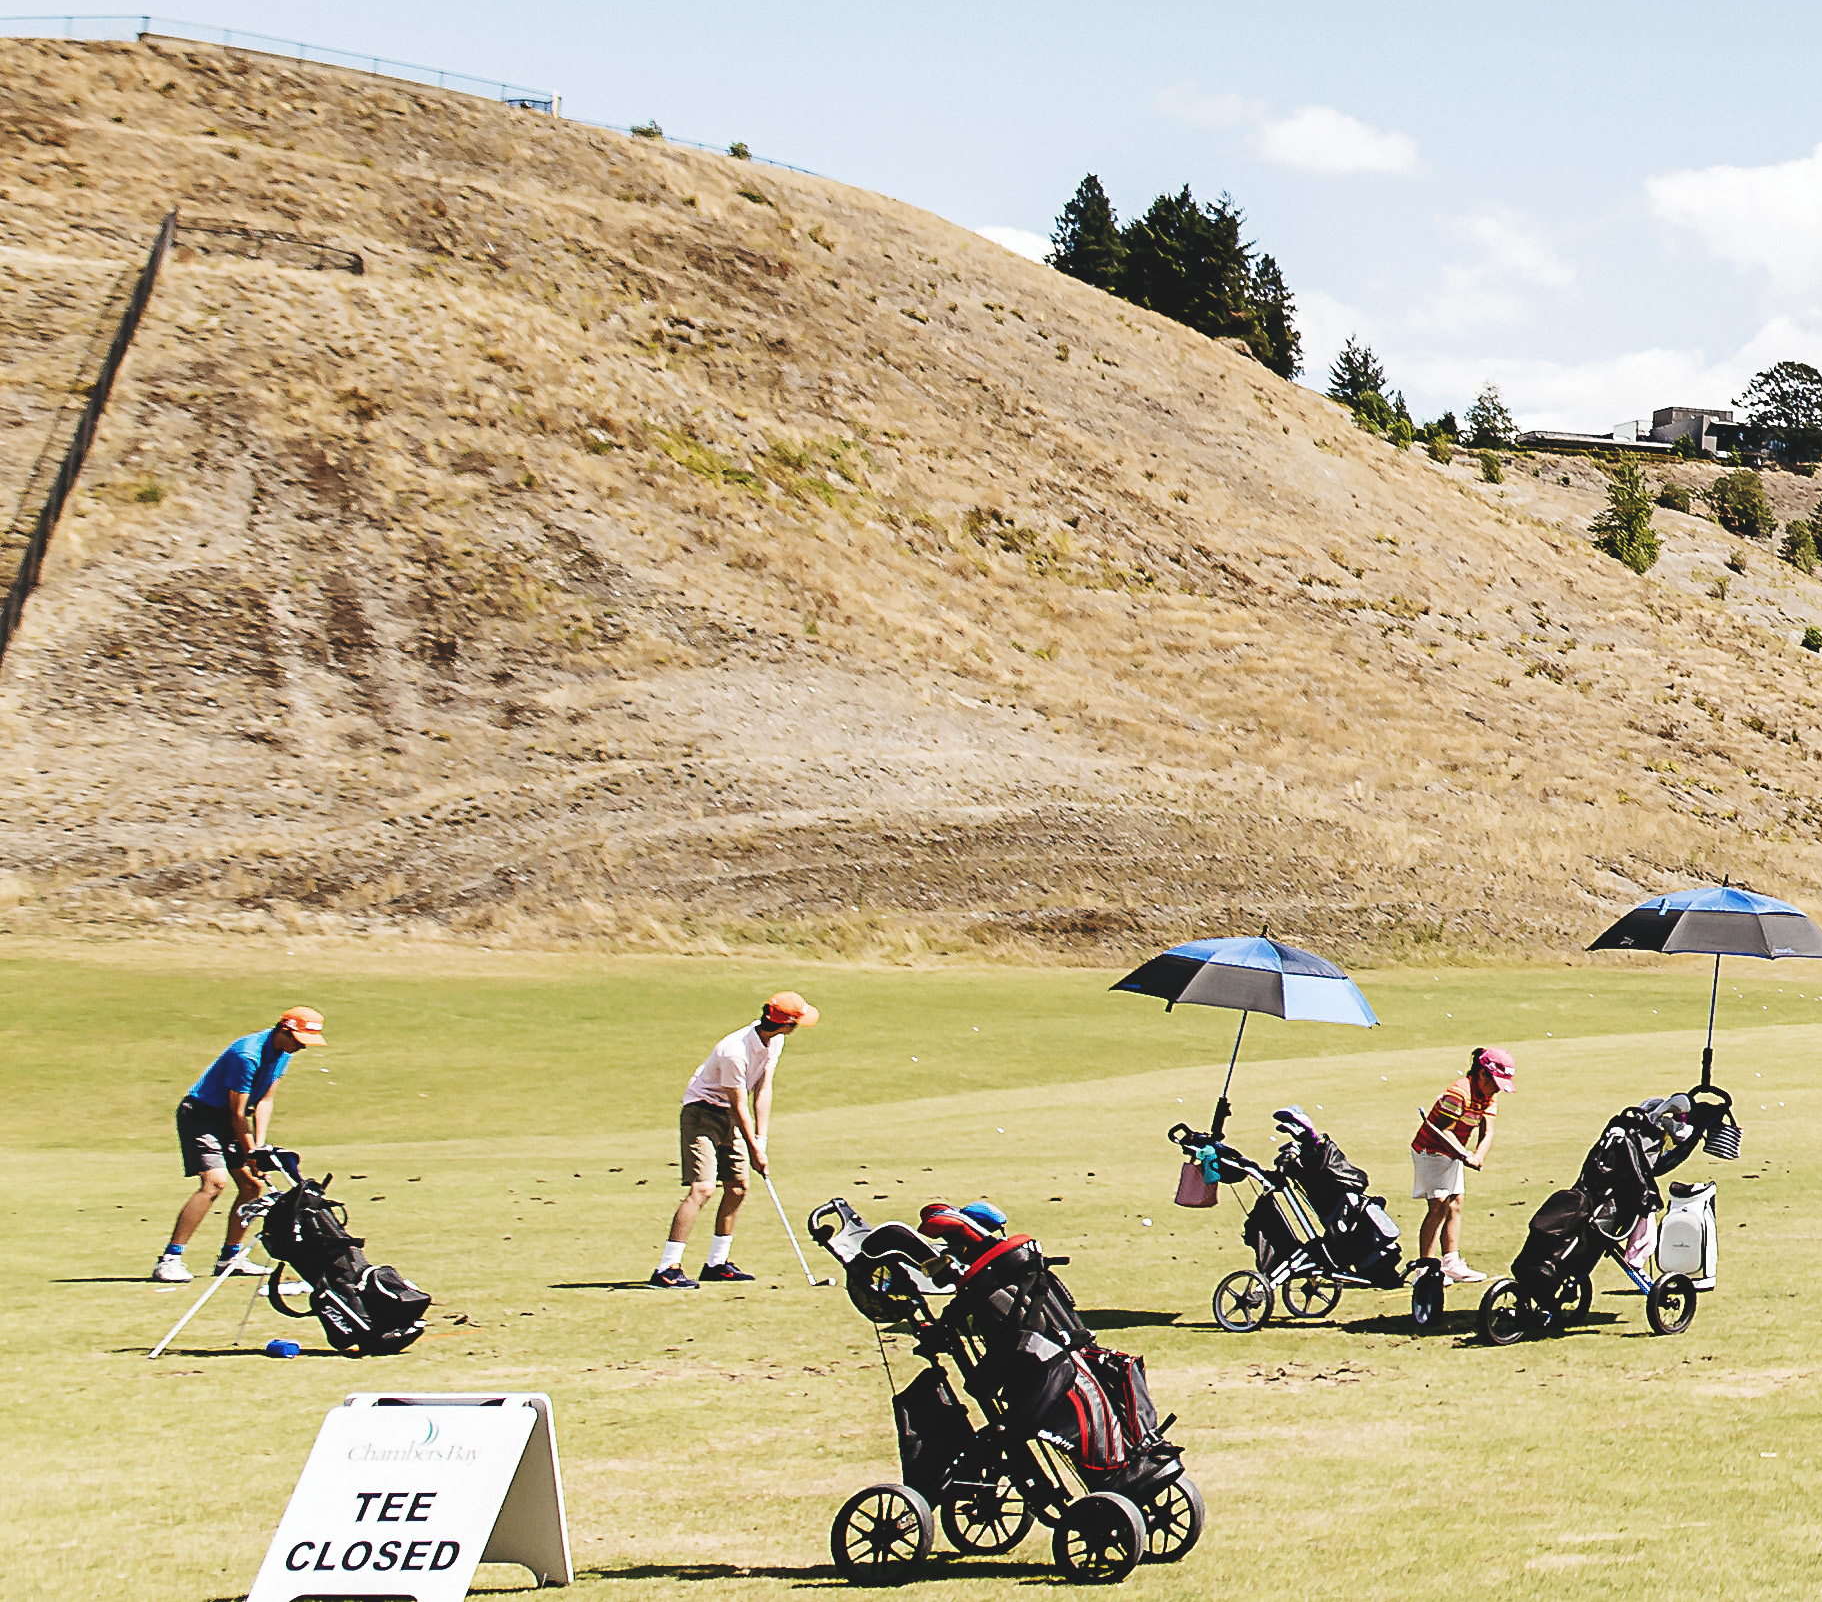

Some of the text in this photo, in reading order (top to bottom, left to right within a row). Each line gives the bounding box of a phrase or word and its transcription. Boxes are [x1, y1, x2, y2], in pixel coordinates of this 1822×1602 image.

[347, 1440, 481, 1467] Chambers Bay
[354, 1491, 438, 1523] TEE
[285, 1540, 461, 1572] CLOSED
